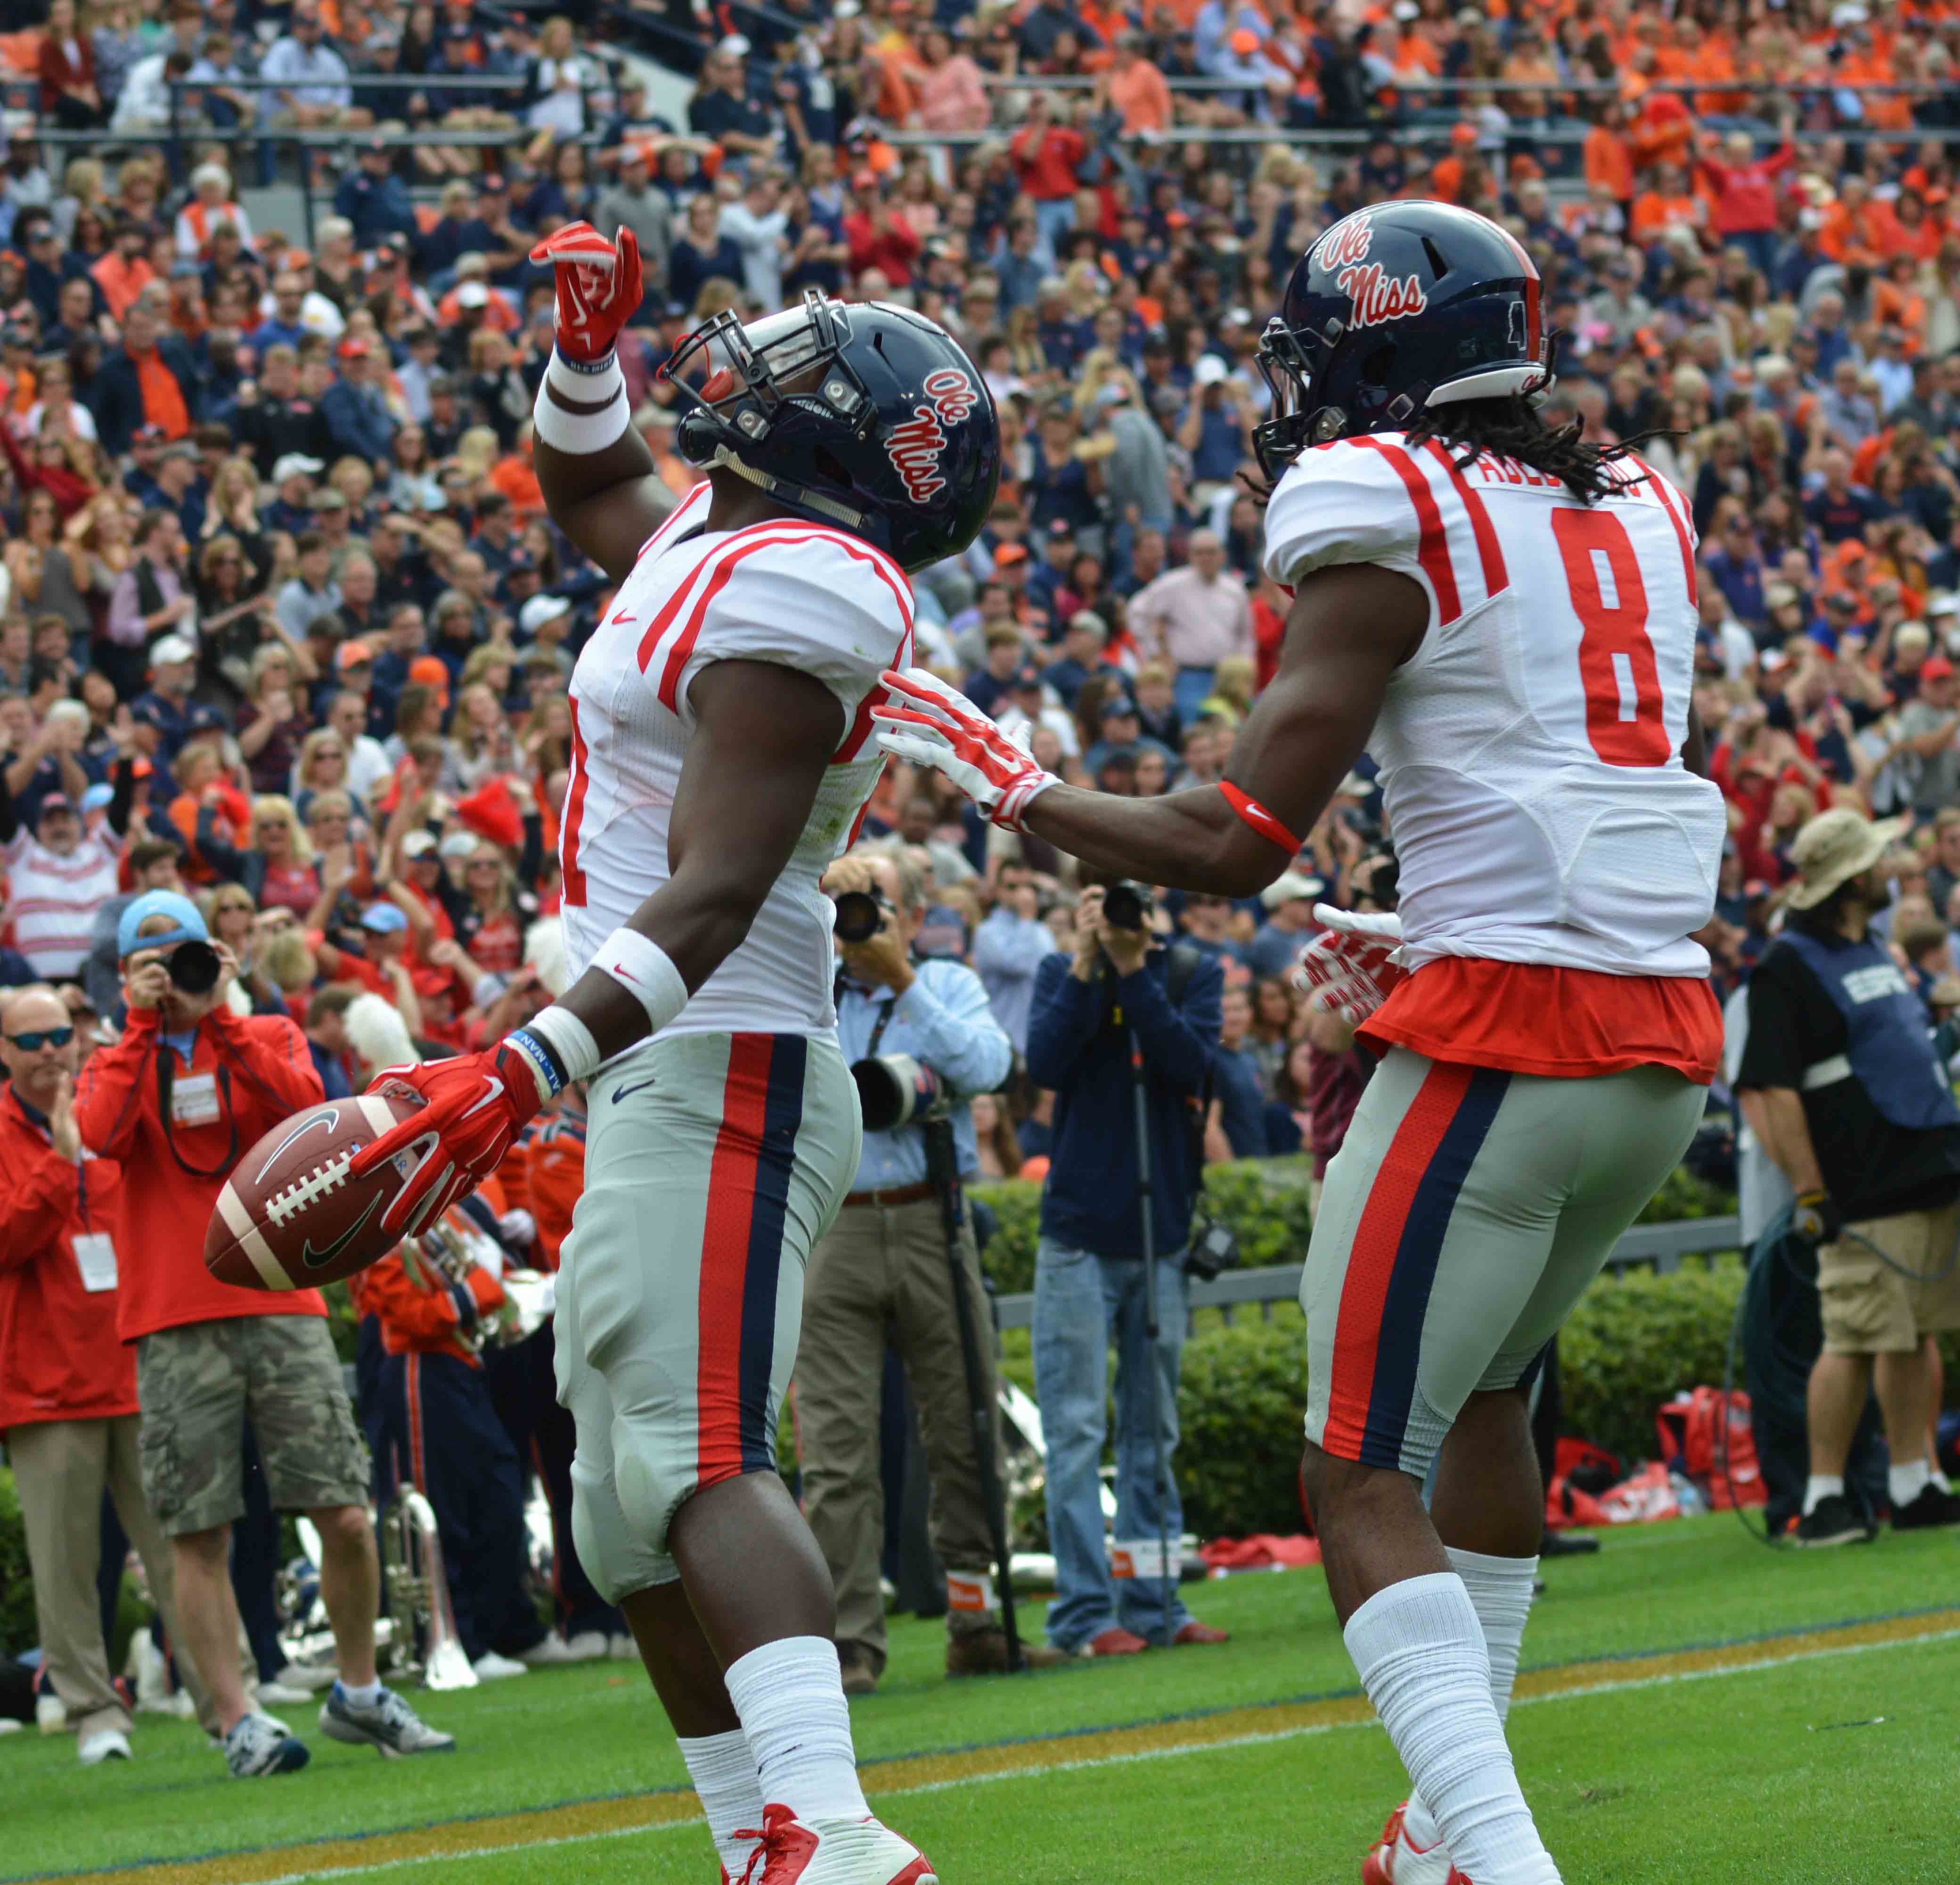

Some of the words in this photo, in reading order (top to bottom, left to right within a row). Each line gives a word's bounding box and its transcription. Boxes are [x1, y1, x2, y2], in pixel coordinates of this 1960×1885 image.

[1320, 215, 1373, 272] Ole
[1337, 262, 1427, 331] Miss
[923, 368, 978, 426] Ole
[884, 405, 947, 502] Miss
[1551, 508, 1671, 766] 8
[520, 1035, 547, 1063] MAN
